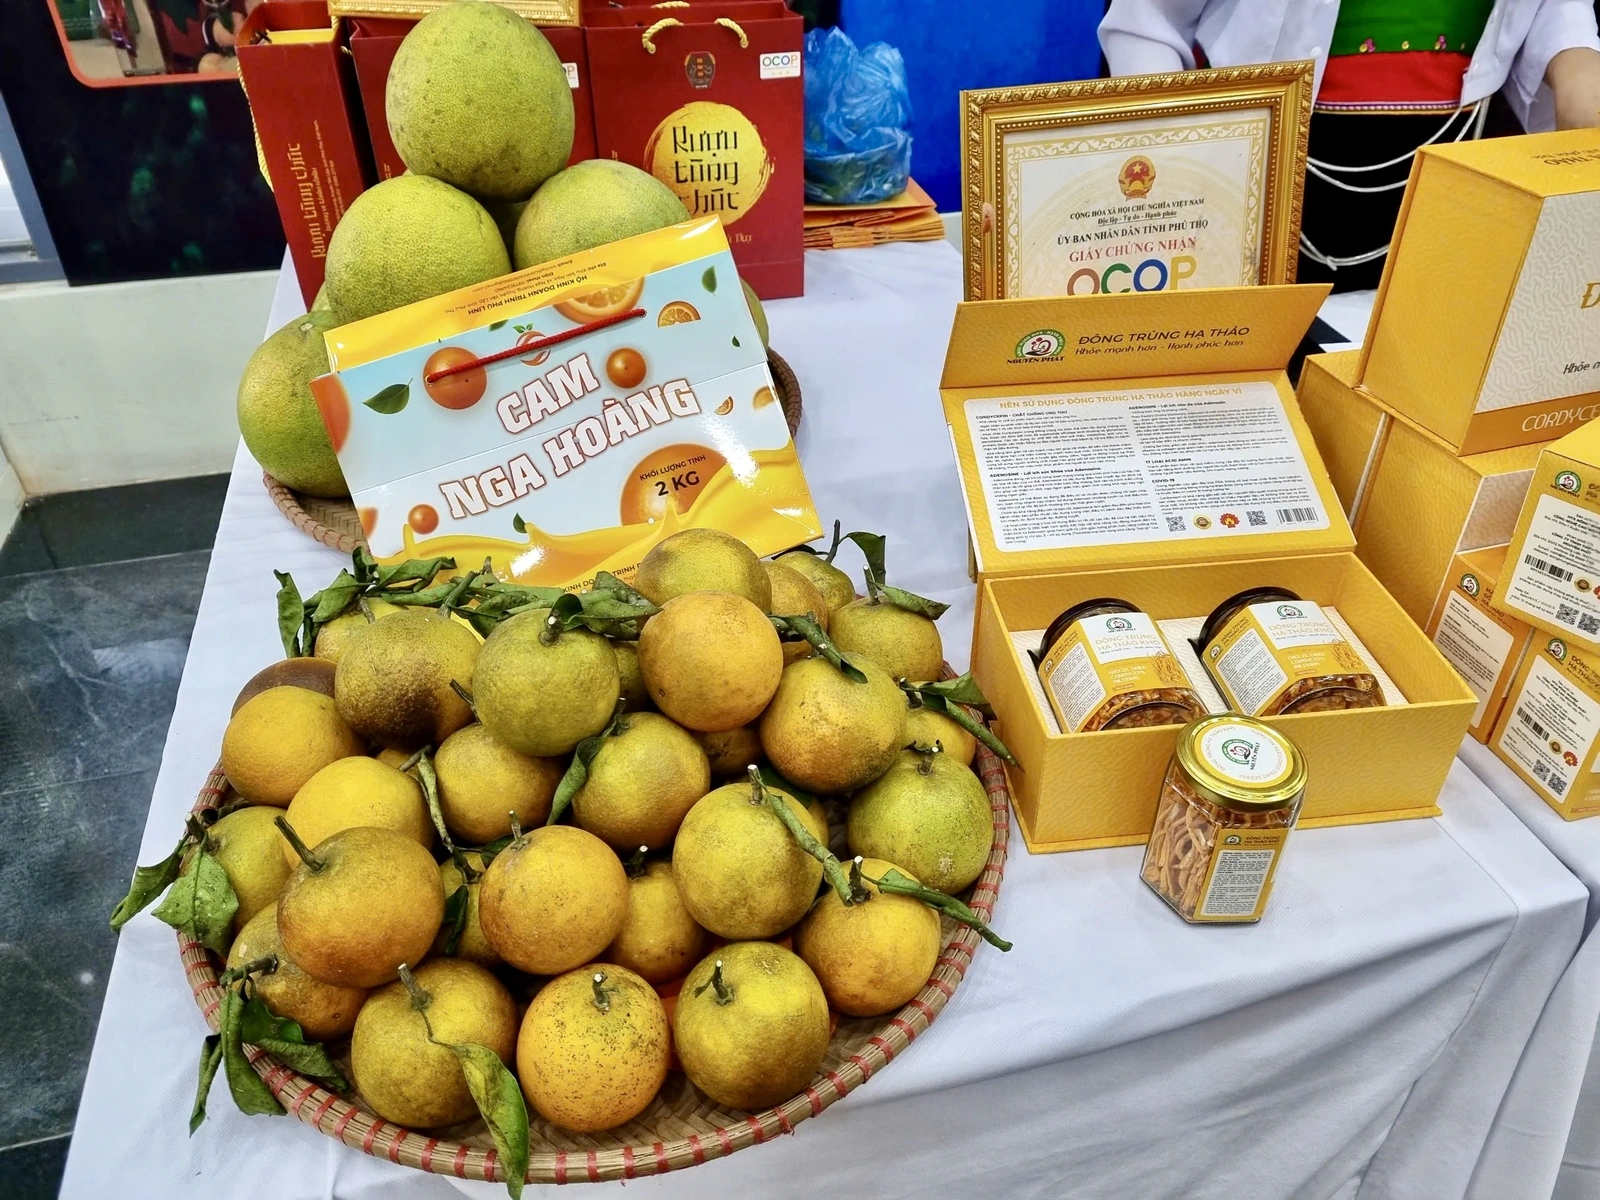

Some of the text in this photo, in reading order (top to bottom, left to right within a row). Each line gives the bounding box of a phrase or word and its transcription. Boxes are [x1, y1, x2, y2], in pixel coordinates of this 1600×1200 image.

[762, 54, 798, 66] OCOP
[1069, 210, 1090, 220] CỘNG
[1106, 207, 1116, 215] XÃ
[1117, 206, 1130, 214] HỘI
[1131, 204, 1146, 212] CHỦ
[1147, 200, 1170, 210] NGHĨA
[1171, 199, 1188, 208] VIỆT
[1097, 217, 1108, 225] Độc
[1109, 216, 1118, 224] lập
[1144, 211, 1161, 219] Hạnh
[1161, 209, 1177, 218] phúc
[1072, 233, 1092, 243] BAN
[1093, 226, 1119, 240] NHÂN
[1120, 224, 1140, 237] DÂN
[1142, 223, 1166, 234] TỈNH
[1167, 219, 1188, 231] PHÚ
[1189, 219, 1209, 230] THỌ
[1068, 235, 1198, 262] GIẤY CHỨNG NHẬN
[1067, 255, 1198, 296] OCOP
[467, 274, 588, 315] HỘ KINH DOANH TRỊNH PHÚ LINH
[1077, 324, 1250, 345] ĐÔNG TRÙNG HẠ THẢO
[1104, 346, 1134, 354] mạnh
[1137, 344, 1157, 352] hơn
[1167, 342, 1193, 350] Hạnh
[1194, 340, 1222, 349] phúc
[1223, 338, 1244, 347] hơn
[496, 352, 600, 436] CAM
[999, 400, 1020, 410] NÊN
[1036, 398, 1064, 408] DỤNG
[1096, 392, 1128, 404] TRÙNG
[1130, 393, 1145, 402] HẠ
[1146, 390, 1173, 401] THẢO
[1174, 387, 1203, 399] HÀNG
[1204, 386, 1230, 397] NGÀY
[438, 377, 702, 522] NGA HOÀNG
[638, 454, 706, 481] KHỐI LƯỢNG TỊNH
[653, 469, 700, 496] 2 KG
[562, 582, 581, 593] KINH
